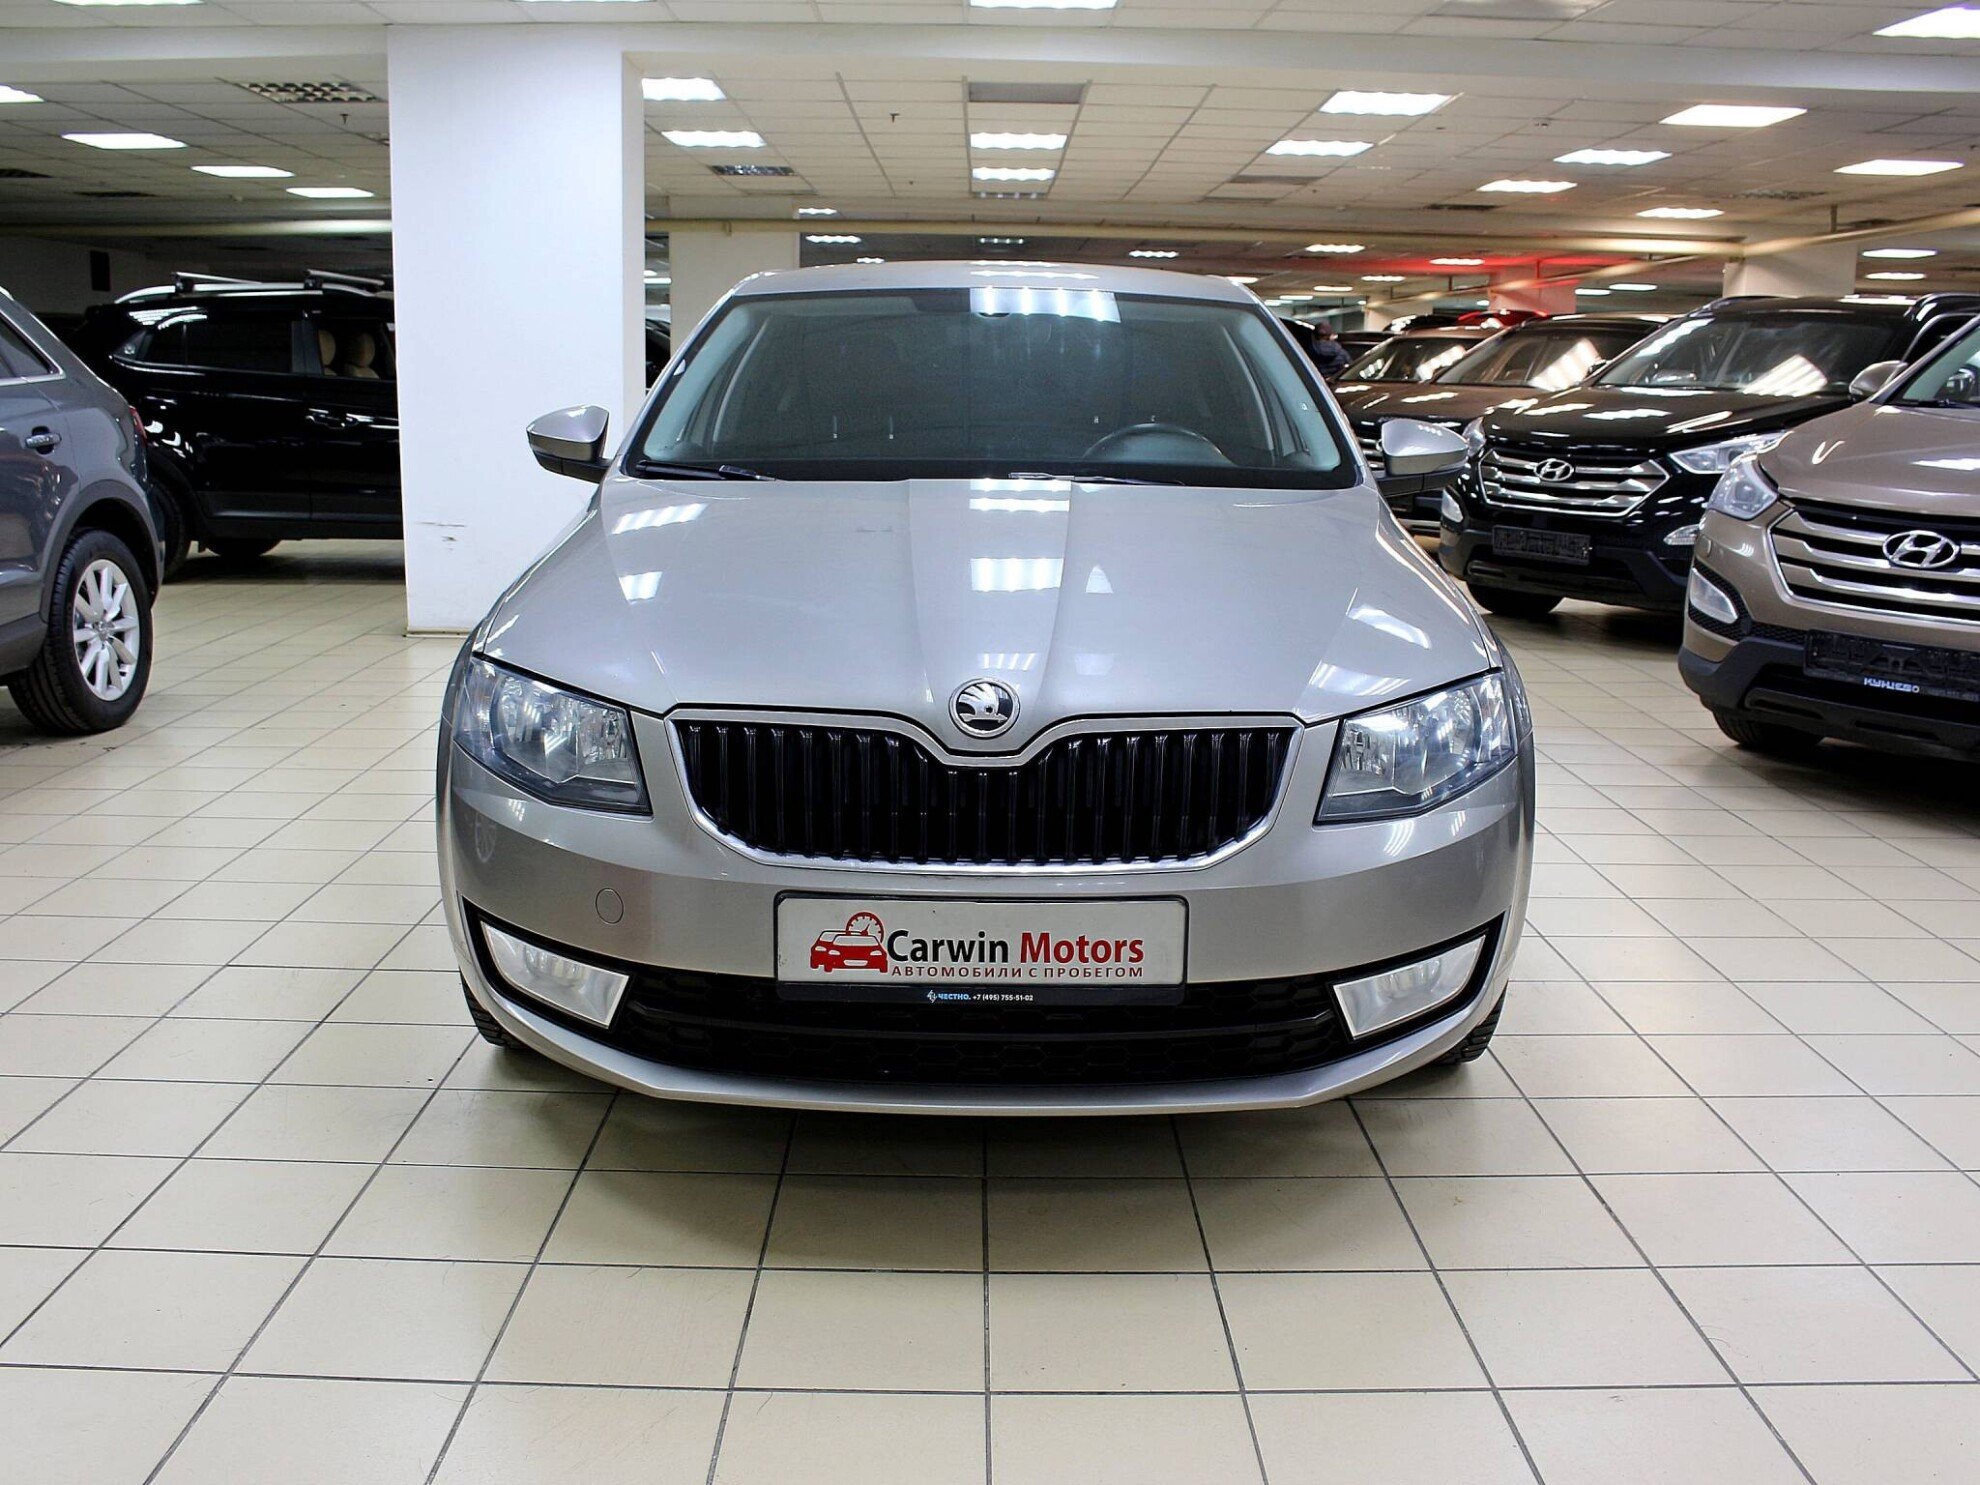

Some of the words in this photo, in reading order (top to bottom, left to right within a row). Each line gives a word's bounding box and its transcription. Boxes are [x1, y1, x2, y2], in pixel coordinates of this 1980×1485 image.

[887, 929, 1009, 963] Carwin
[1021, 932, 1144, 963] Motors
[891, 966, 1022, 978] АВТОМОБИЛИ
[1029, 967, 1038, 978] С
[1044, 967, 1143, 978] ПРОБЕГОМ
